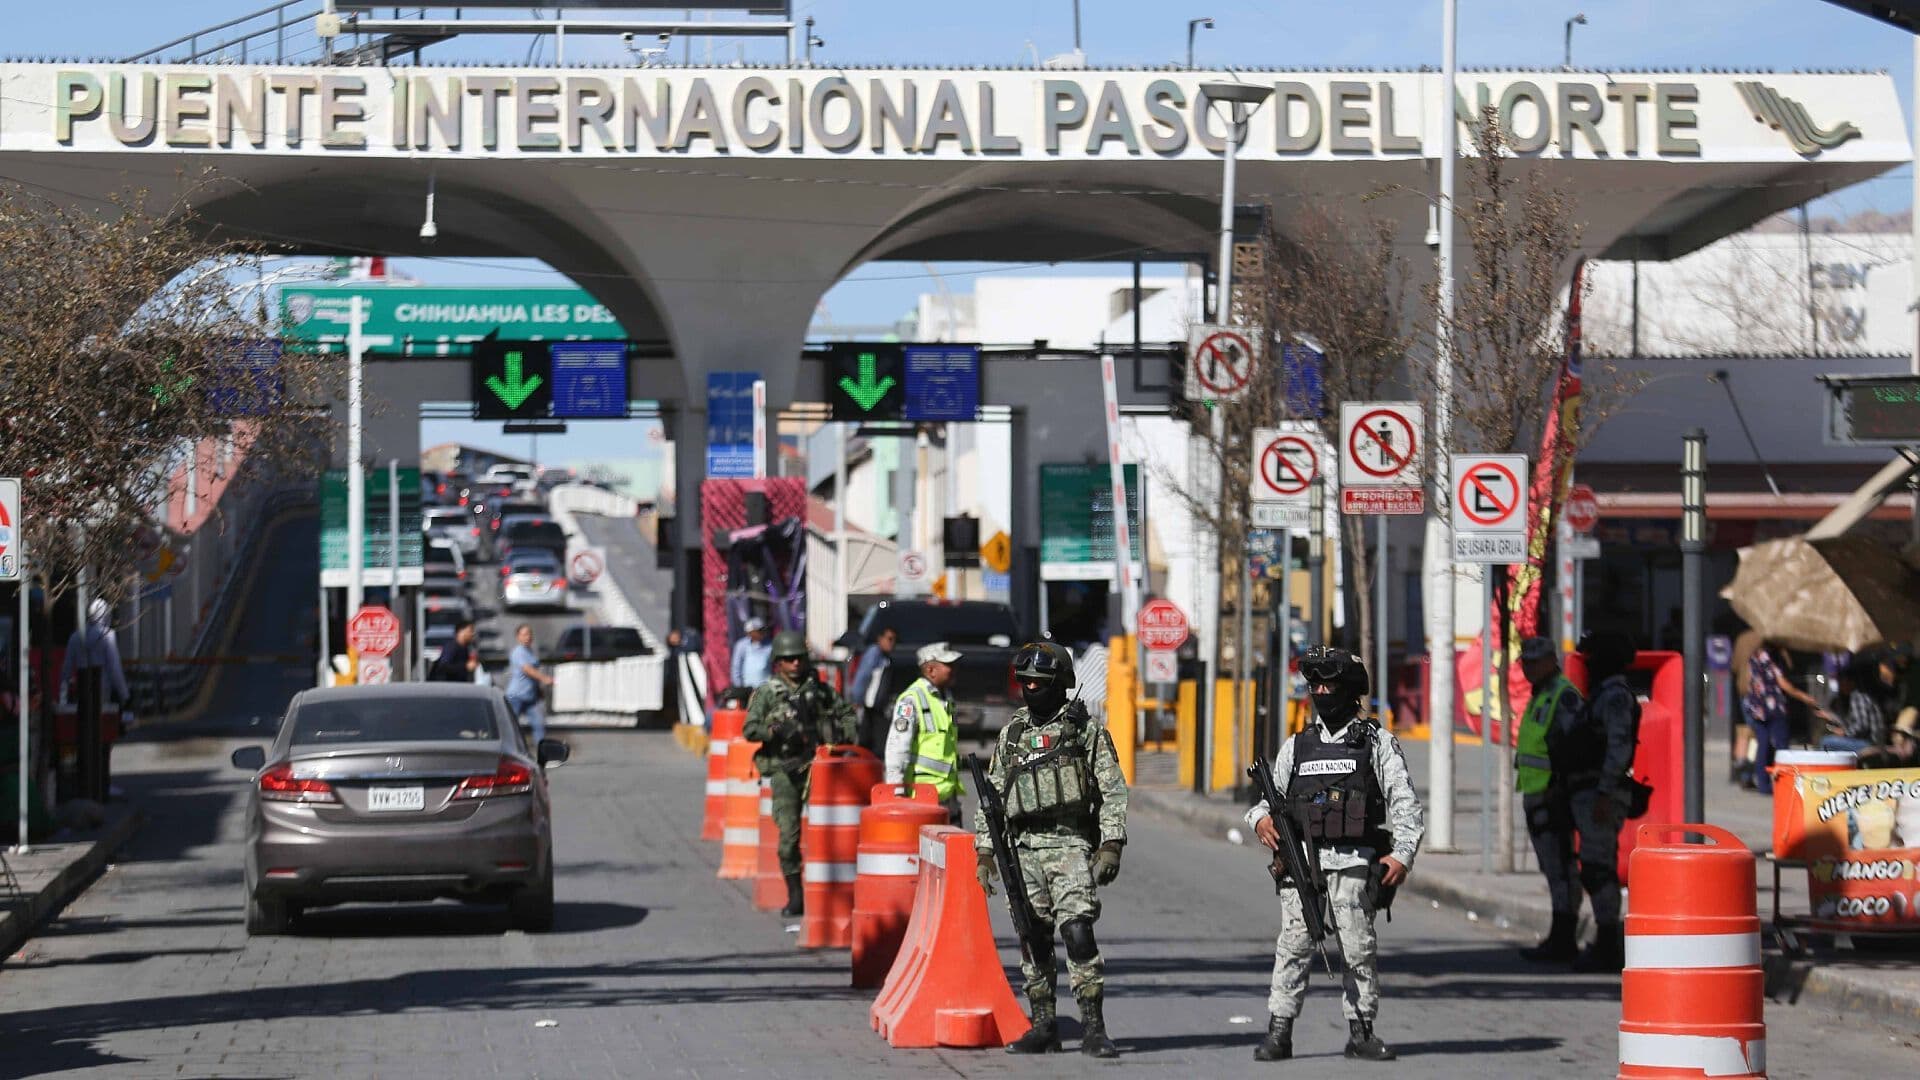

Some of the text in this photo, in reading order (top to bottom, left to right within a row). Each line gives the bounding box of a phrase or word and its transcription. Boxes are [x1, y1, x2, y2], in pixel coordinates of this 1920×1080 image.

[56, 70, 366, 148] PUENTE
[392, 74, 1021, 156] INTERNACIONAL
[1043, 78, 1249, 155] PASO
[1274, 80, 1424, 155] DEL
[394, 303, 529, 323] CHIHUAHUA
[531, 304, 571, 323] LES
[356, 616, 393, 632] ALTO
[1145, 630, 1184, 645] STOP
[1300, 761, 1355, 774] GUARDIA NACIONAL
[1817, 783, 1871, 823] NIEVE
[1876, 779, 1905, 801] DE
[1832, 860, 1904, 881] MANGO
[1836, 895, 1890, 918] COCO
